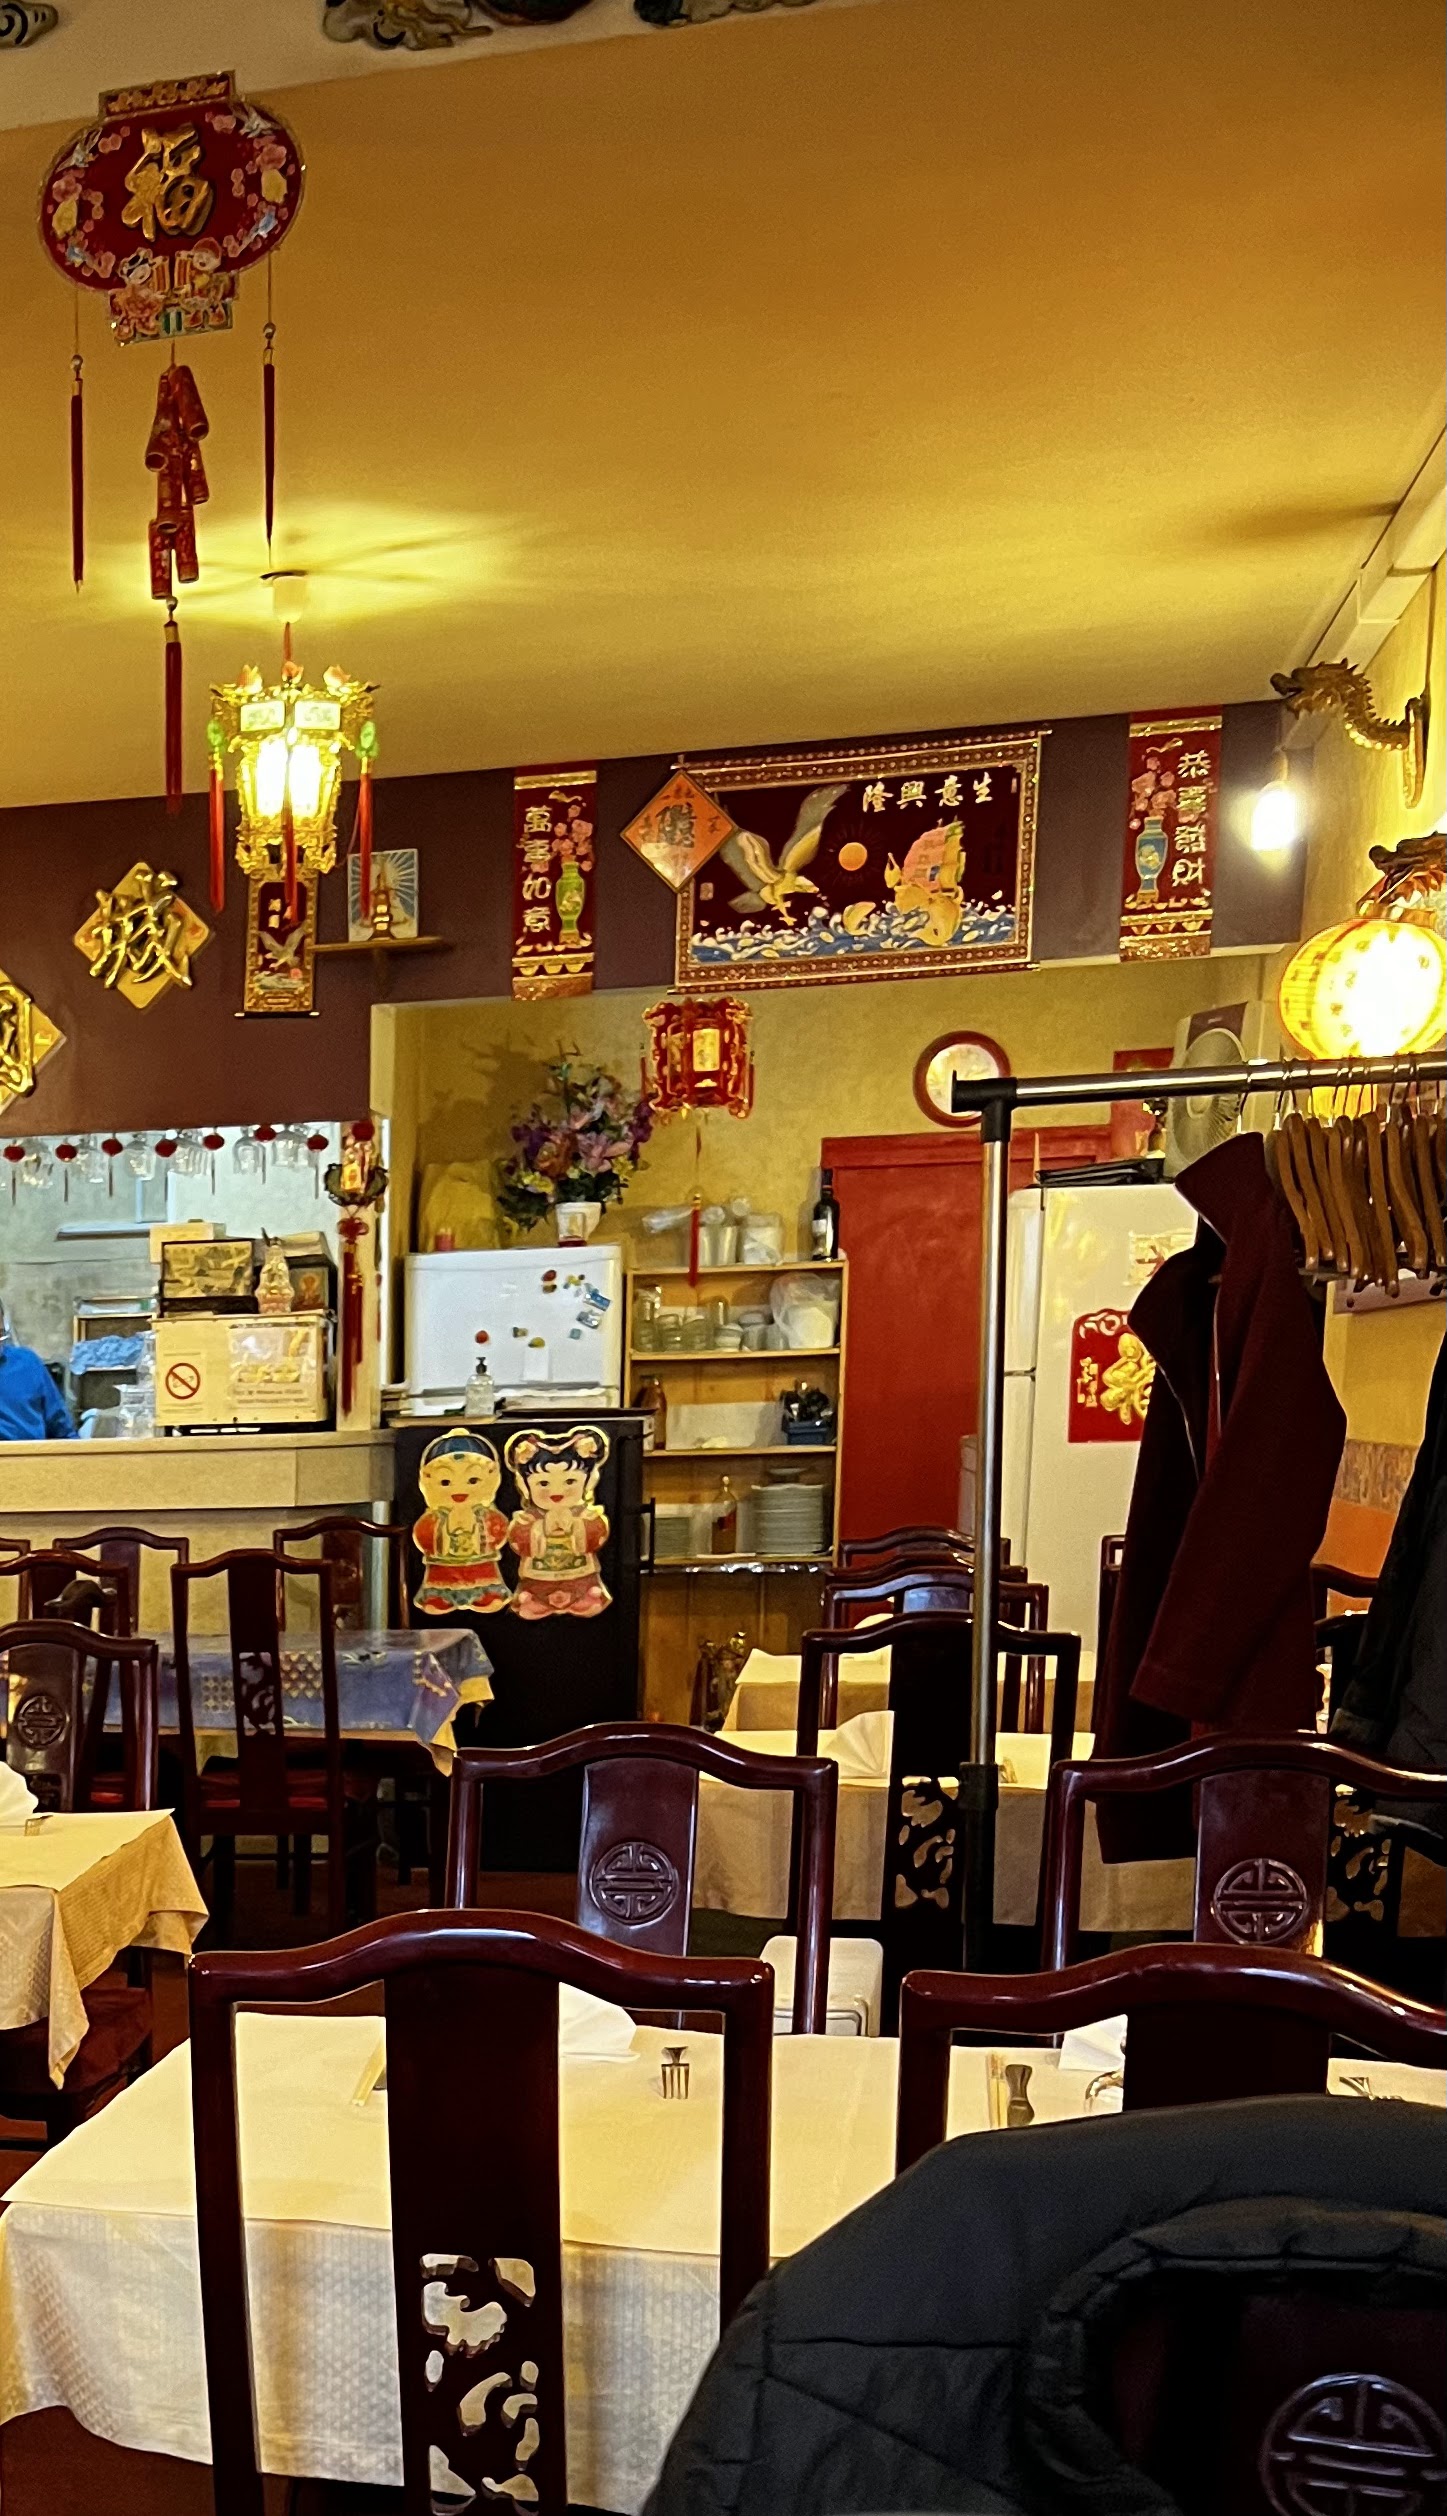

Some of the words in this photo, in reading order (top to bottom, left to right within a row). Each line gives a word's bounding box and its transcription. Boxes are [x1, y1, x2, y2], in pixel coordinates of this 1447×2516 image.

[121, 121, 215, 243] 福
[1171, 749, 1213, 888] 恭喜發財
